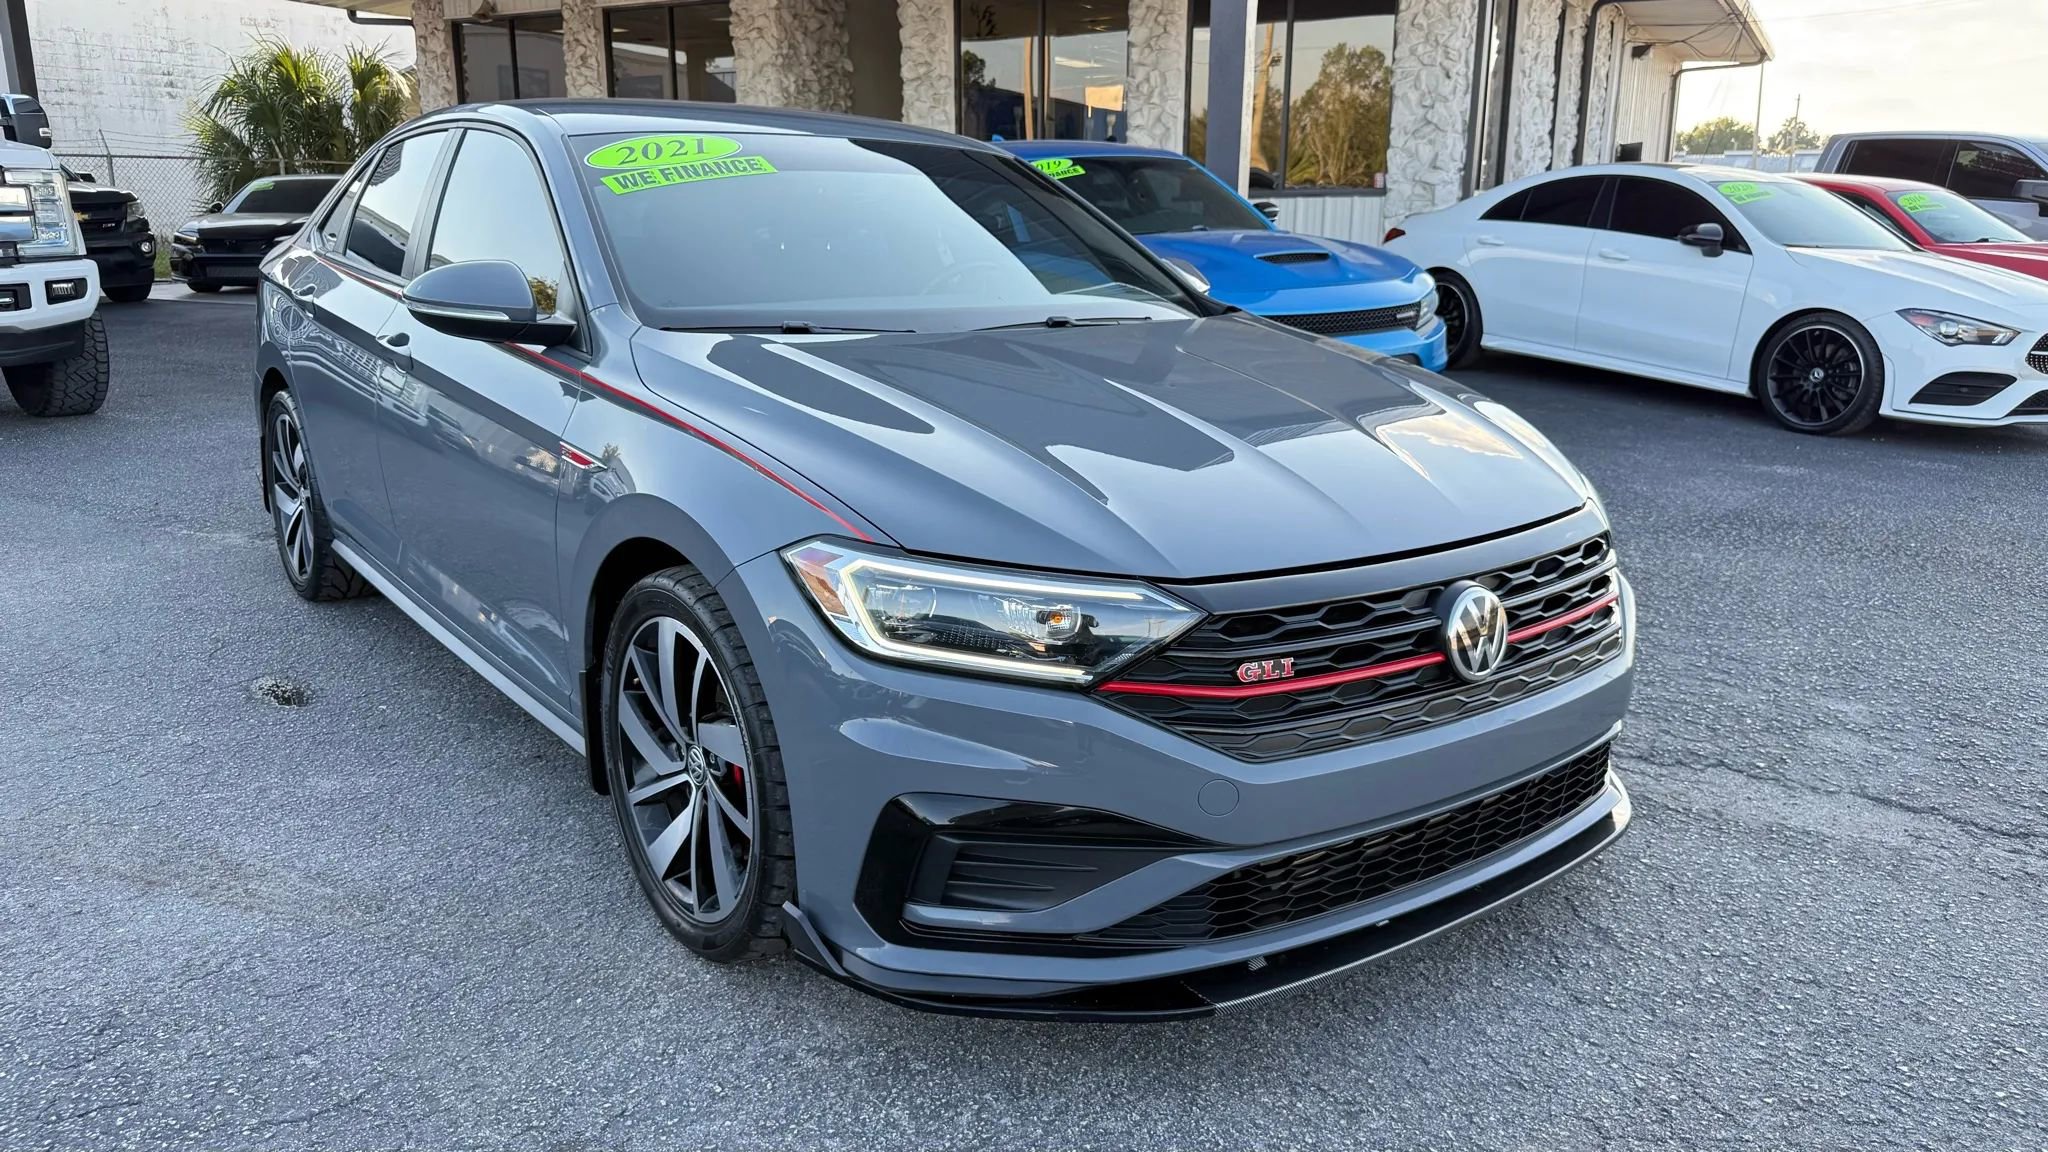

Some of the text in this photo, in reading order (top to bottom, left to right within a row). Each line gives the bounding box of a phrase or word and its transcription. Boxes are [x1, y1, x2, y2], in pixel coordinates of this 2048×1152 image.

[615, 138, 708, 166] 2021
[1035, 160, 1062, 170] 019
[613, 158, 764, 190] WE FINANCE
[1236, 657, 1295, 683] GLI
